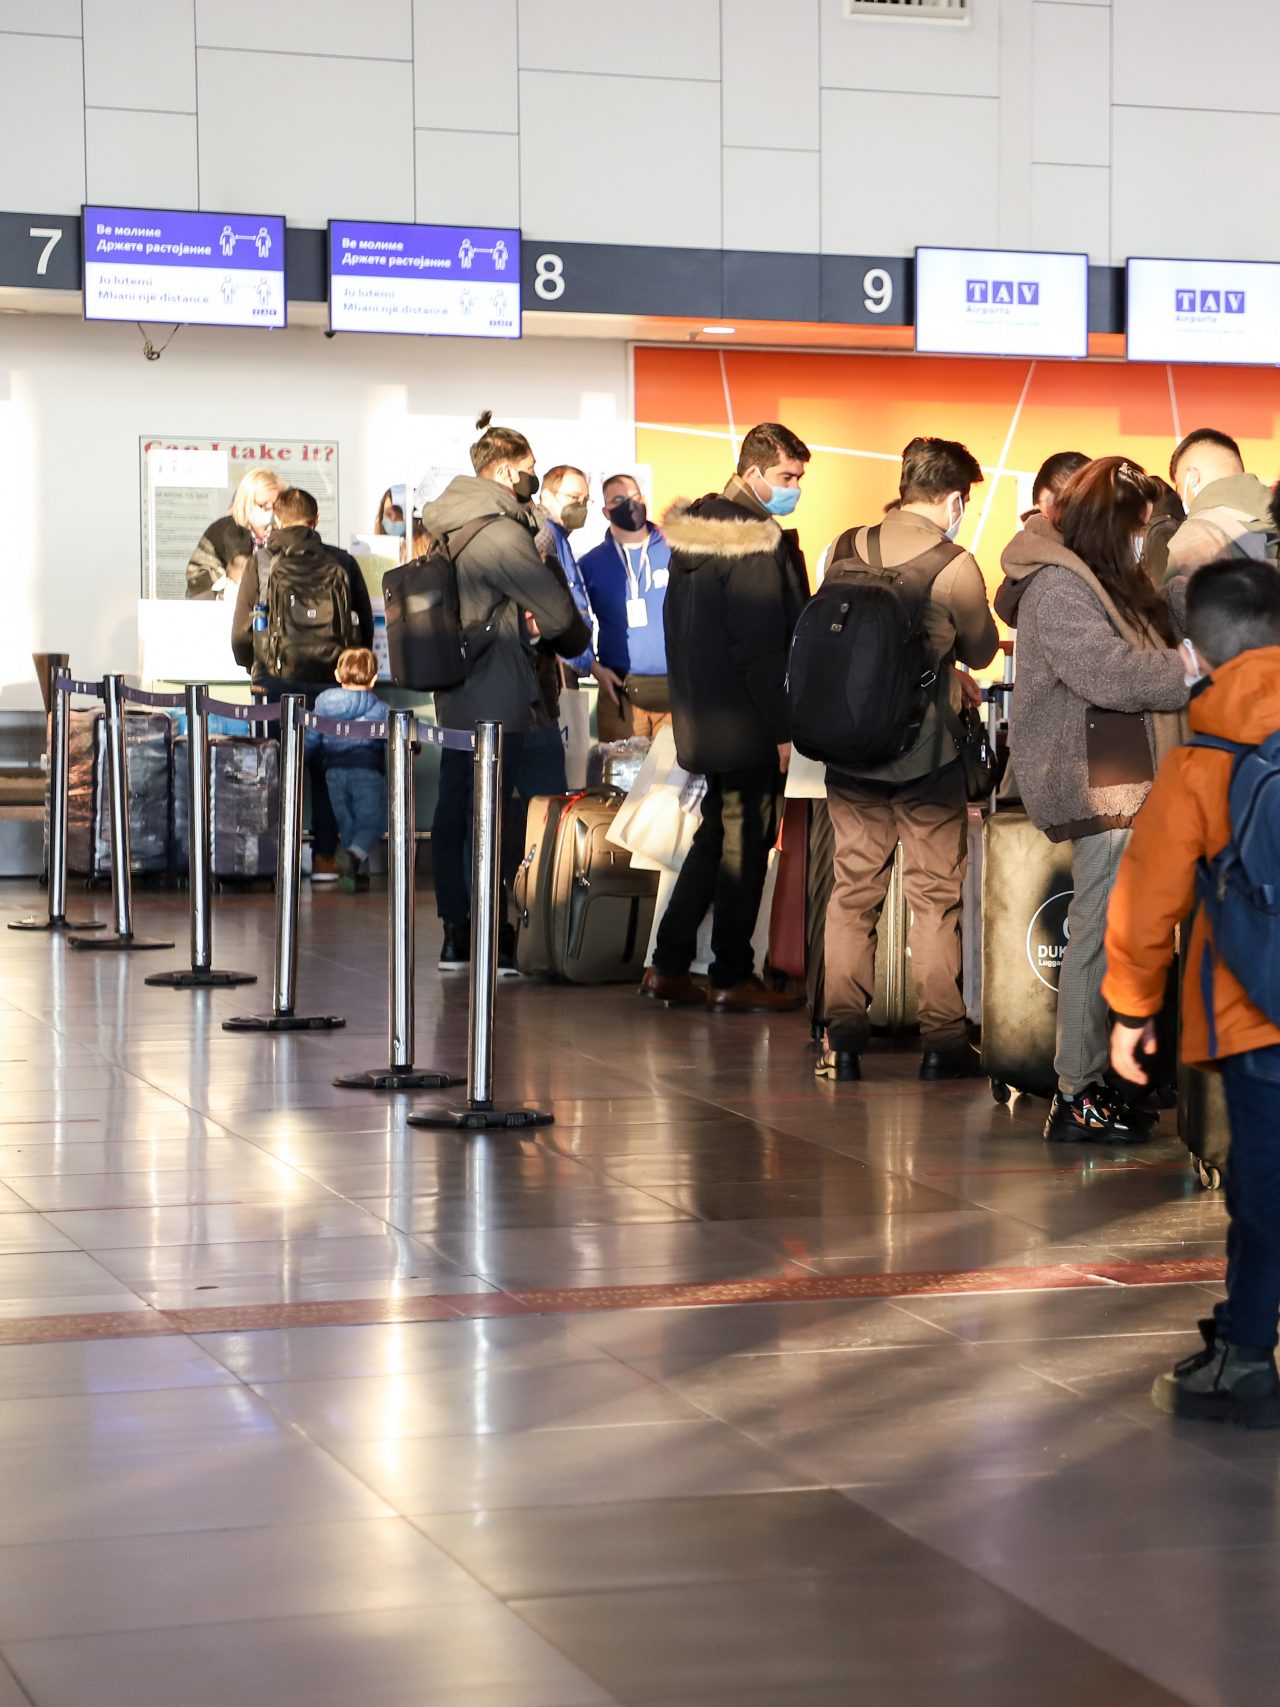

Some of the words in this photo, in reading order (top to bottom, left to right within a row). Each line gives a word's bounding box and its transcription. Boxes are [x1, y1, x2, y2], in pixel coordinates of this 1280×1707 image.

[96, 224, 112, 235] Ве
[115, 226, 162, 237] молиме
[29, 227, 63, 275] 7
[96, 239, 144, 252] Држете
[146, 242, 212, 256] растојание
[341, 238, 357, 249] Ве
[359, 239, 404, 251] молиме
[341, 252, 386, 265] Држете
[388, 255, 452, 269] растојание
[534, 253, 566, 301] 8
[863, 268, 893, 314] 9
[967, 281, 1038, 304] TAV
[1175, 290, 1245, 313] TAV
[230, 443, 292, 461] take
[302, 444, 334, 462] it?
[1038, 945, 1067, 958] DUK
[1038, 959, 1062, 967] Lugga
